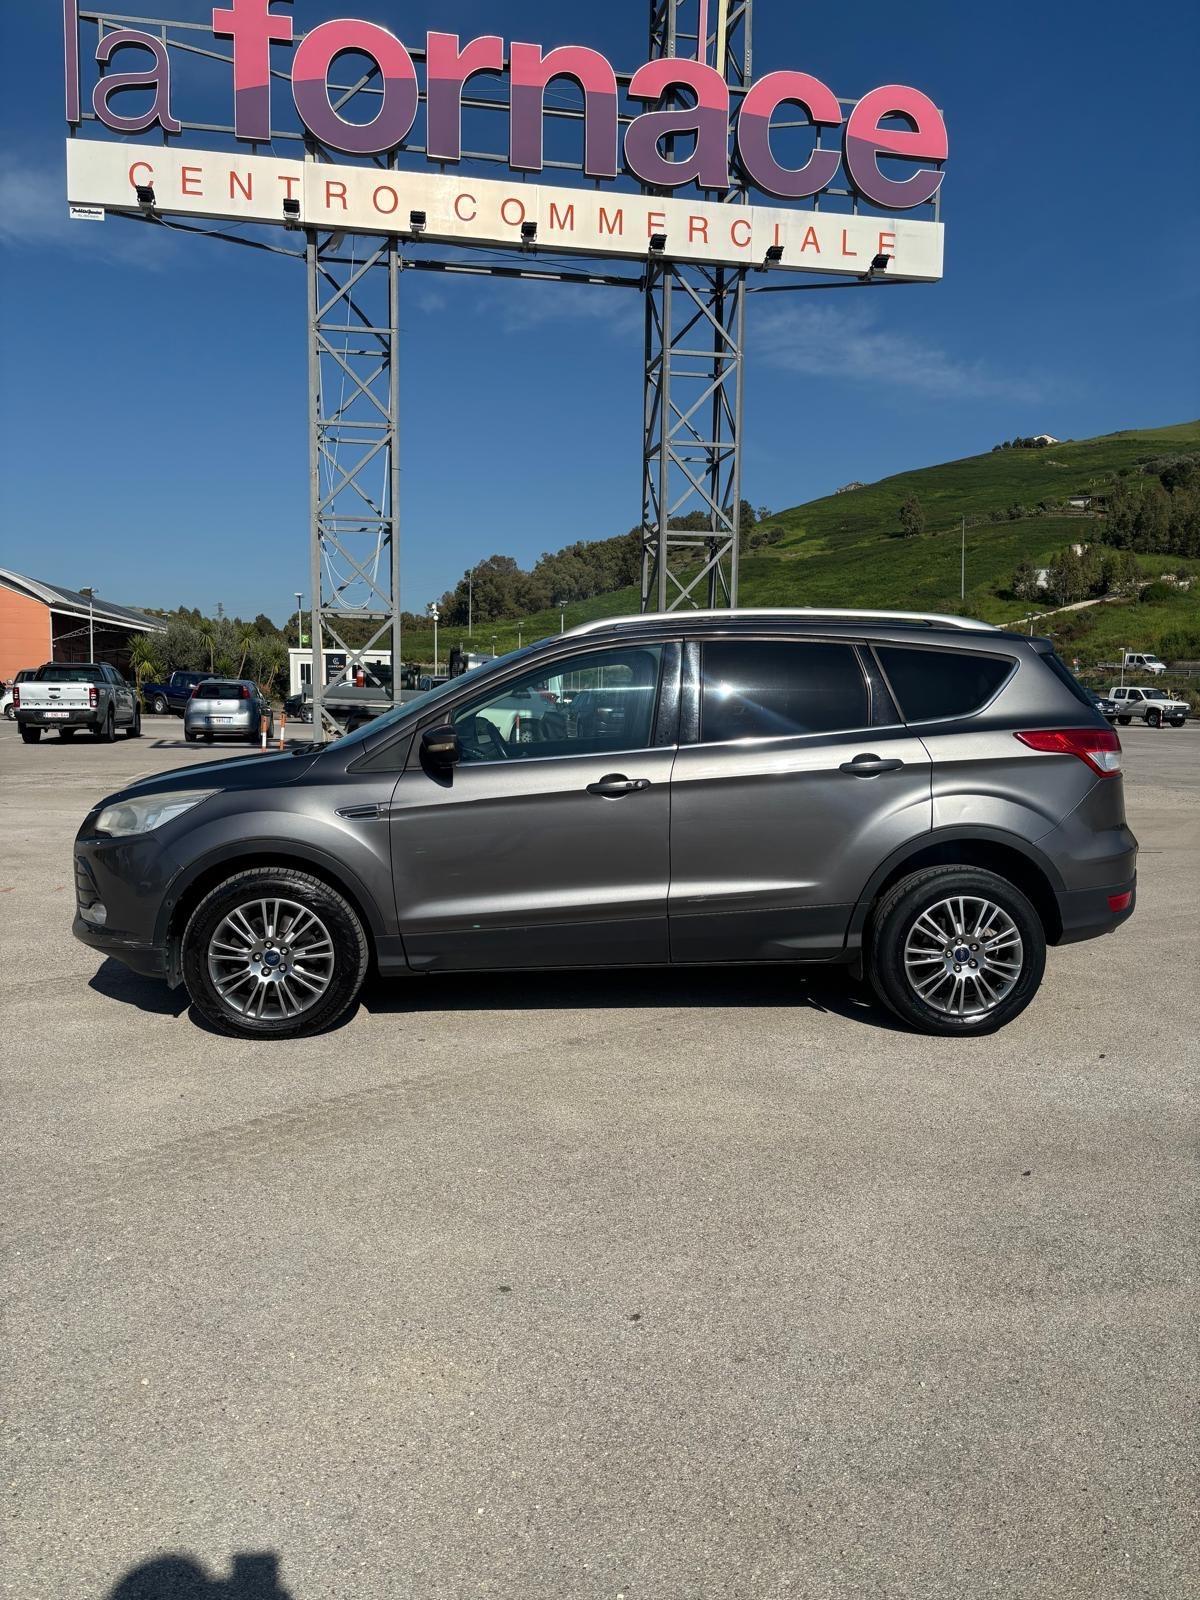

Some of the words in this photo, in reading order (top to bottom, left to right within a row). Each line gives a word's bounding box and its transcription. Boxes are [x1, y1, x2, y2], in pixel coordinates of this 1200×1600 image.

[63, 0, 181, 132] la
[212, 0, 948, 208] fornace
[129, 161, 399, 214] CENTRO
[454, 192, 896, 260] COMMERCIALE
